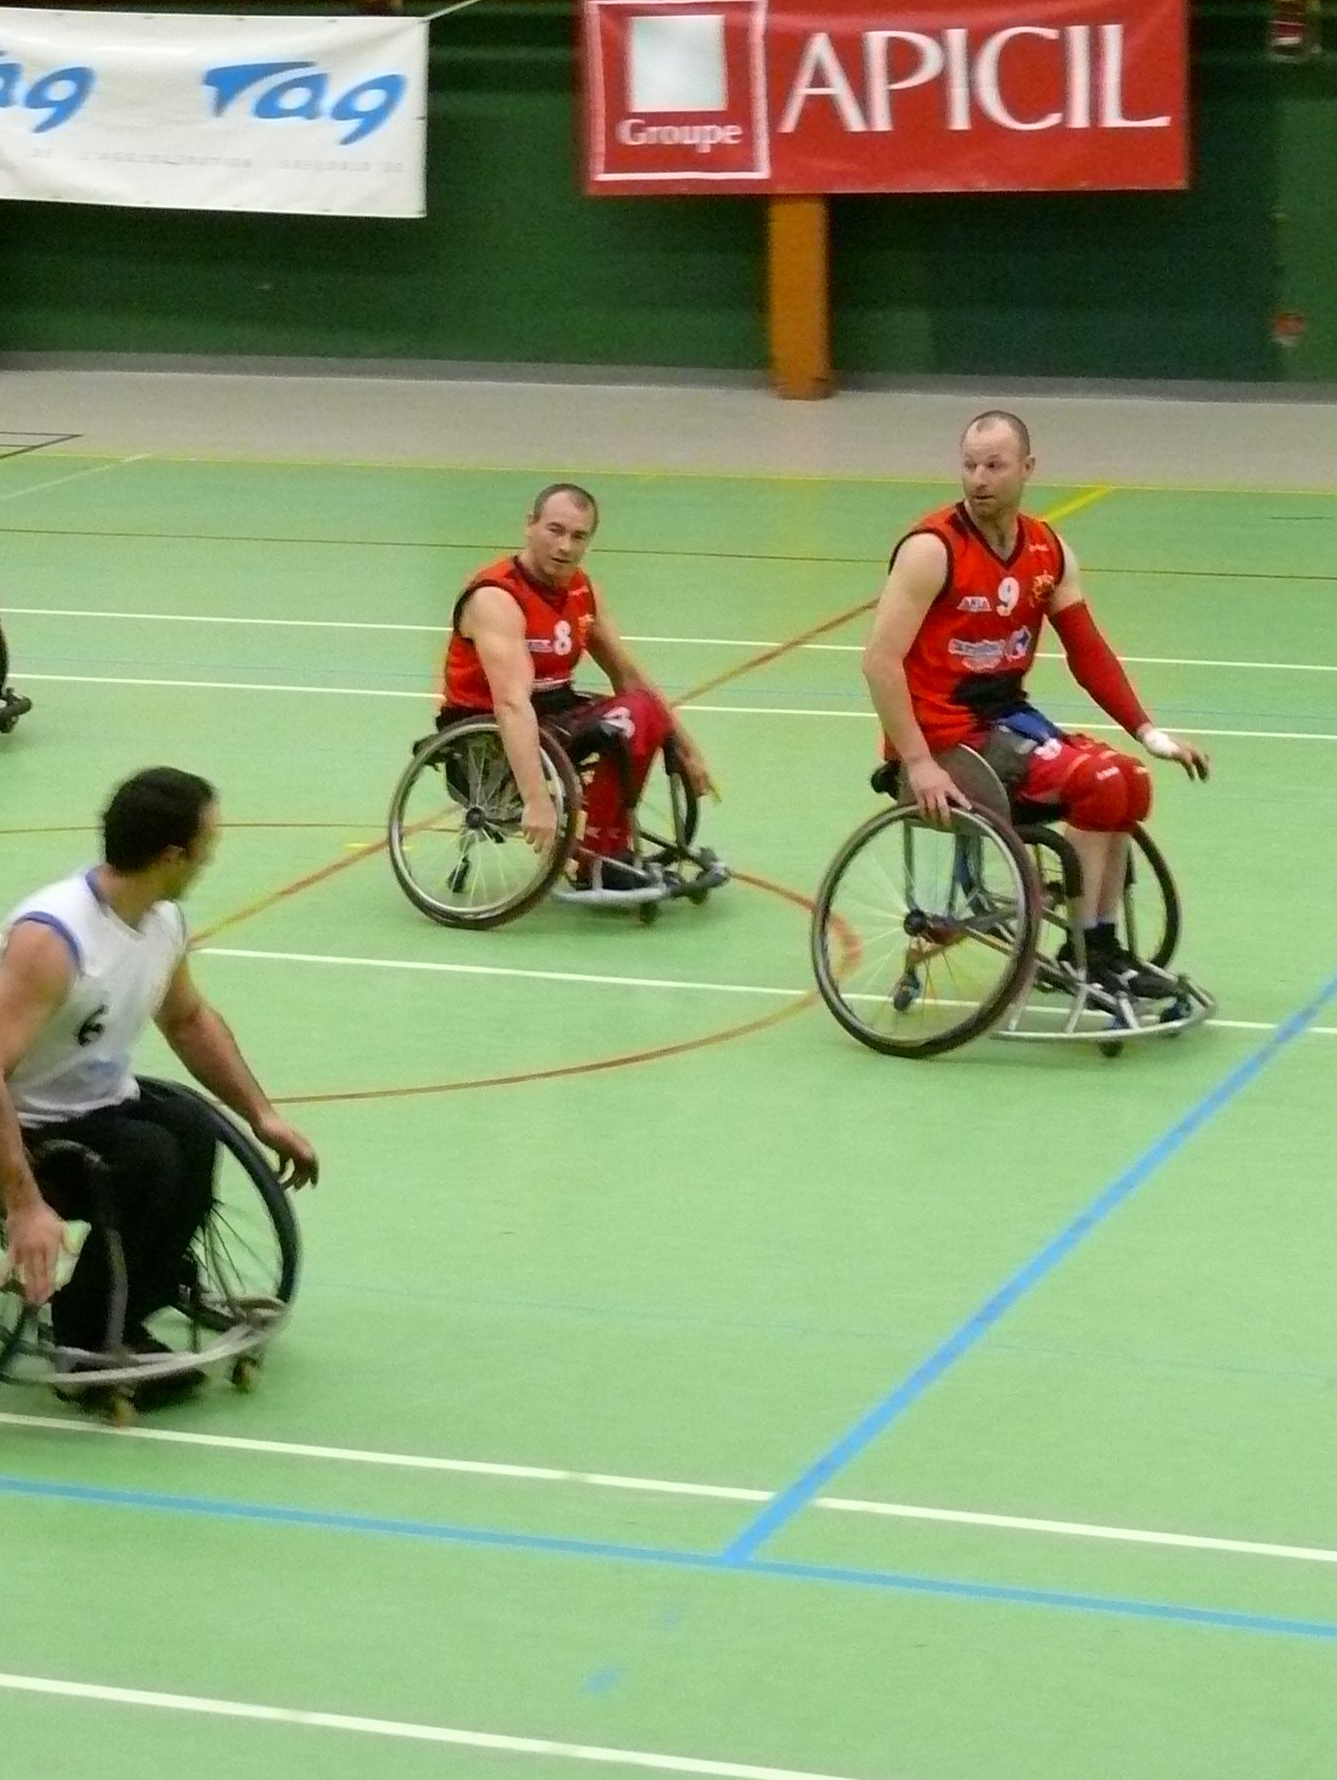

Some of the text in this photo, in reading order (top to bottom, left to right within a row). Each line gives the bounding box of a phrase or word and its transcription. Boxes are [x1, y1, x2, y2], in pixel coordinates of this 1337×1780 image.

[779, 24, 1170, 131] APICIL
[203, 61, 407, 145] Tag
[616, 117, 742, 152] Groupe
[996, 577, 1020, 616] 9
[554, 620, 572, 656] 8
[78, 1004, 108, 1047] 6
